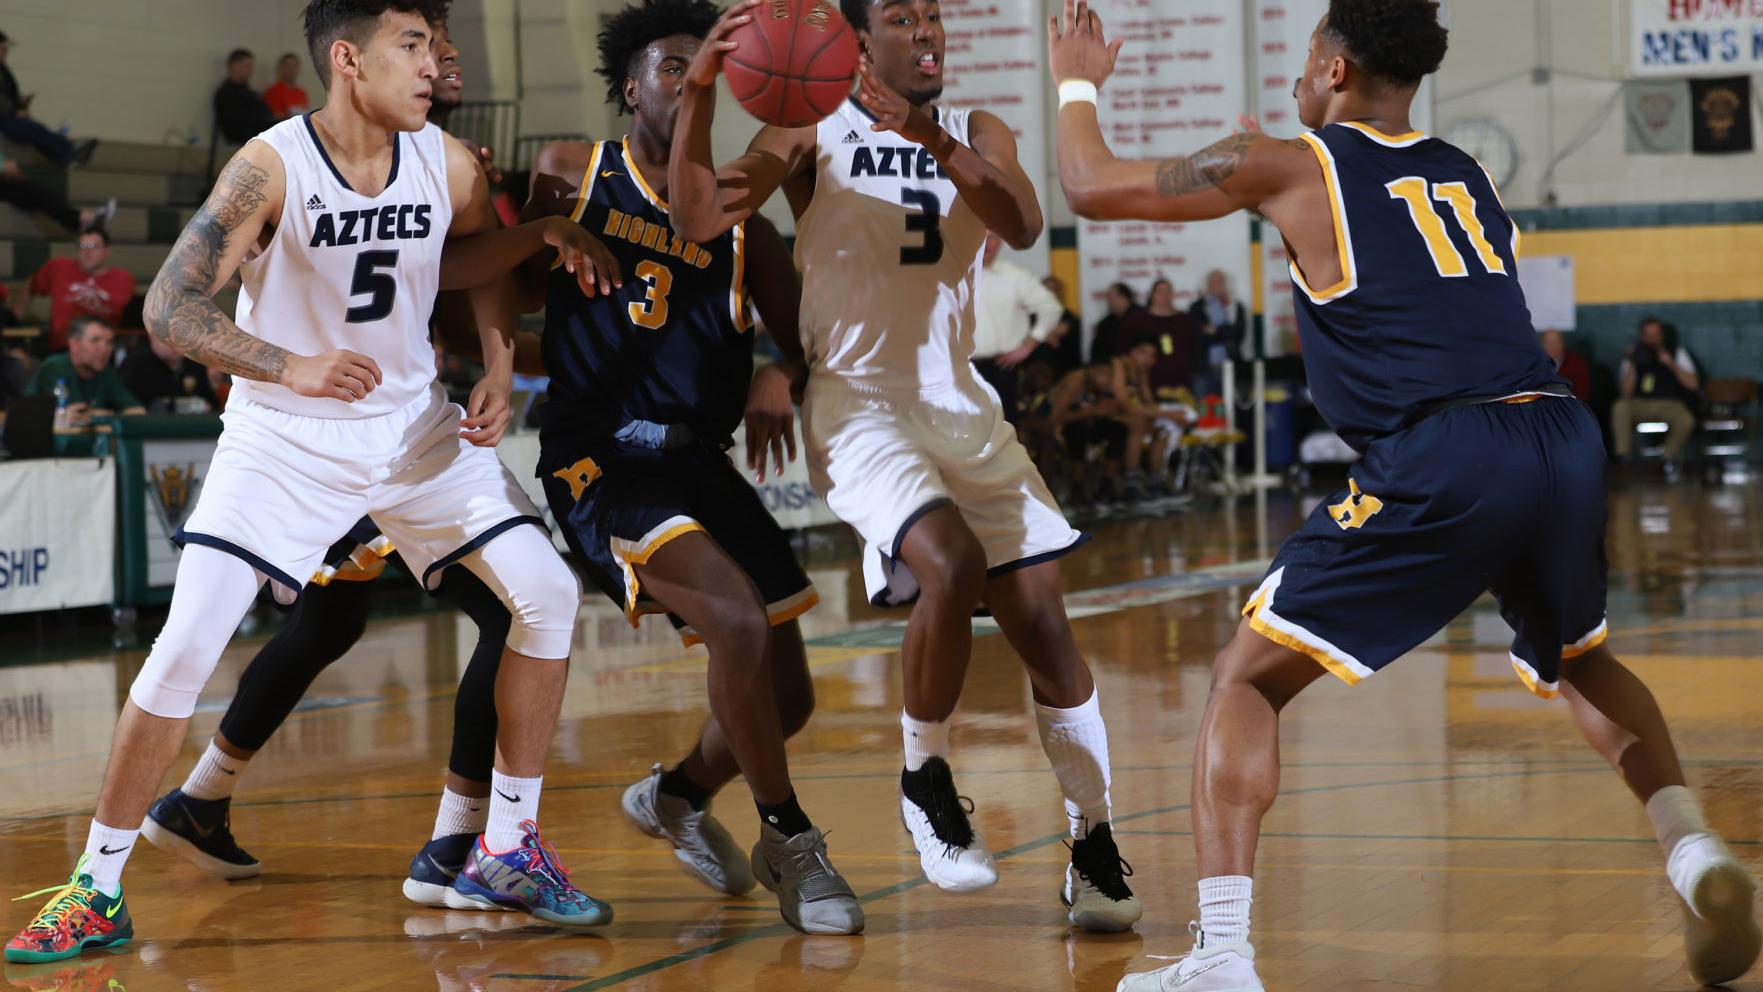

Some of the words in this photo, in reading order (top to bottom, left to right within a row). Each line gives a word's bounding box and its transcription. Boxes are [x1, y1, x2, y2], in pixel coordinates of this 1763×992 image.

[309, 204, 431, 248] AZTECS
[603, 208, 713, 270] HIGHLAND
[900, 186, 944, 265] 3
[1384, 176, 1509, 277] 11
[344, 249, 400, 323] 5
[628, 259, 673, 330] 3
[0, 547, 49, 589] SHIP
